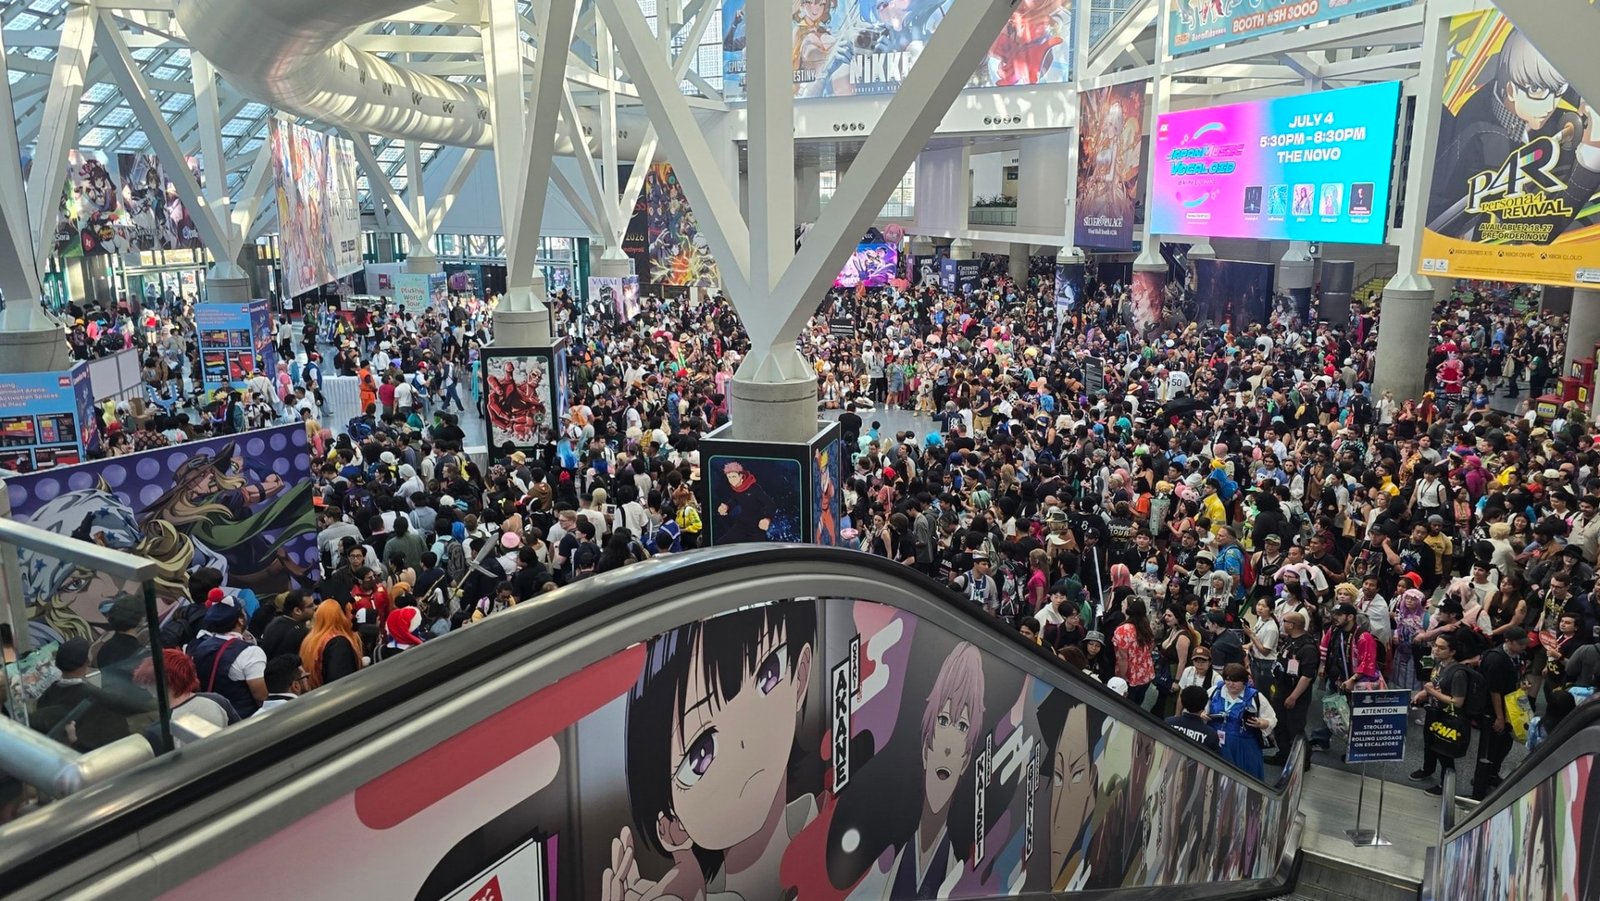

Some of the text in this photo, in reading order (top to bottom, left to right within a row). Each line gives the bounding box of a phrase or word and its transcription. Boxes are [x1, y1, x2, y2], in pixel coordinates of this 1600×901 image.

[1232, 14, 1264, 33] BOOTH
[793, 69, 815, 82] ESTINY
[1288, 112, 1334, 128] JULY 4
[1260, 133, 1304, 148] 5:30PM
[1314, 127, 1366, 143] 8:30PM
[1277, 147, 1341, 163] THE NOVO
[1503, 200, 1573, 218] REVIVAL
[1480, 223, 1521, 232] AVAILABLE
[626, 233, 645, 241] 2026
[1526, 232, 1548, 241] NOW
[623, 246, 645, 254] nchyroll
[1171, 378, 1182, 387] 50
[835, 669, 848, 788] AKANE
[1171, 724, 1207, 744] CURITY
